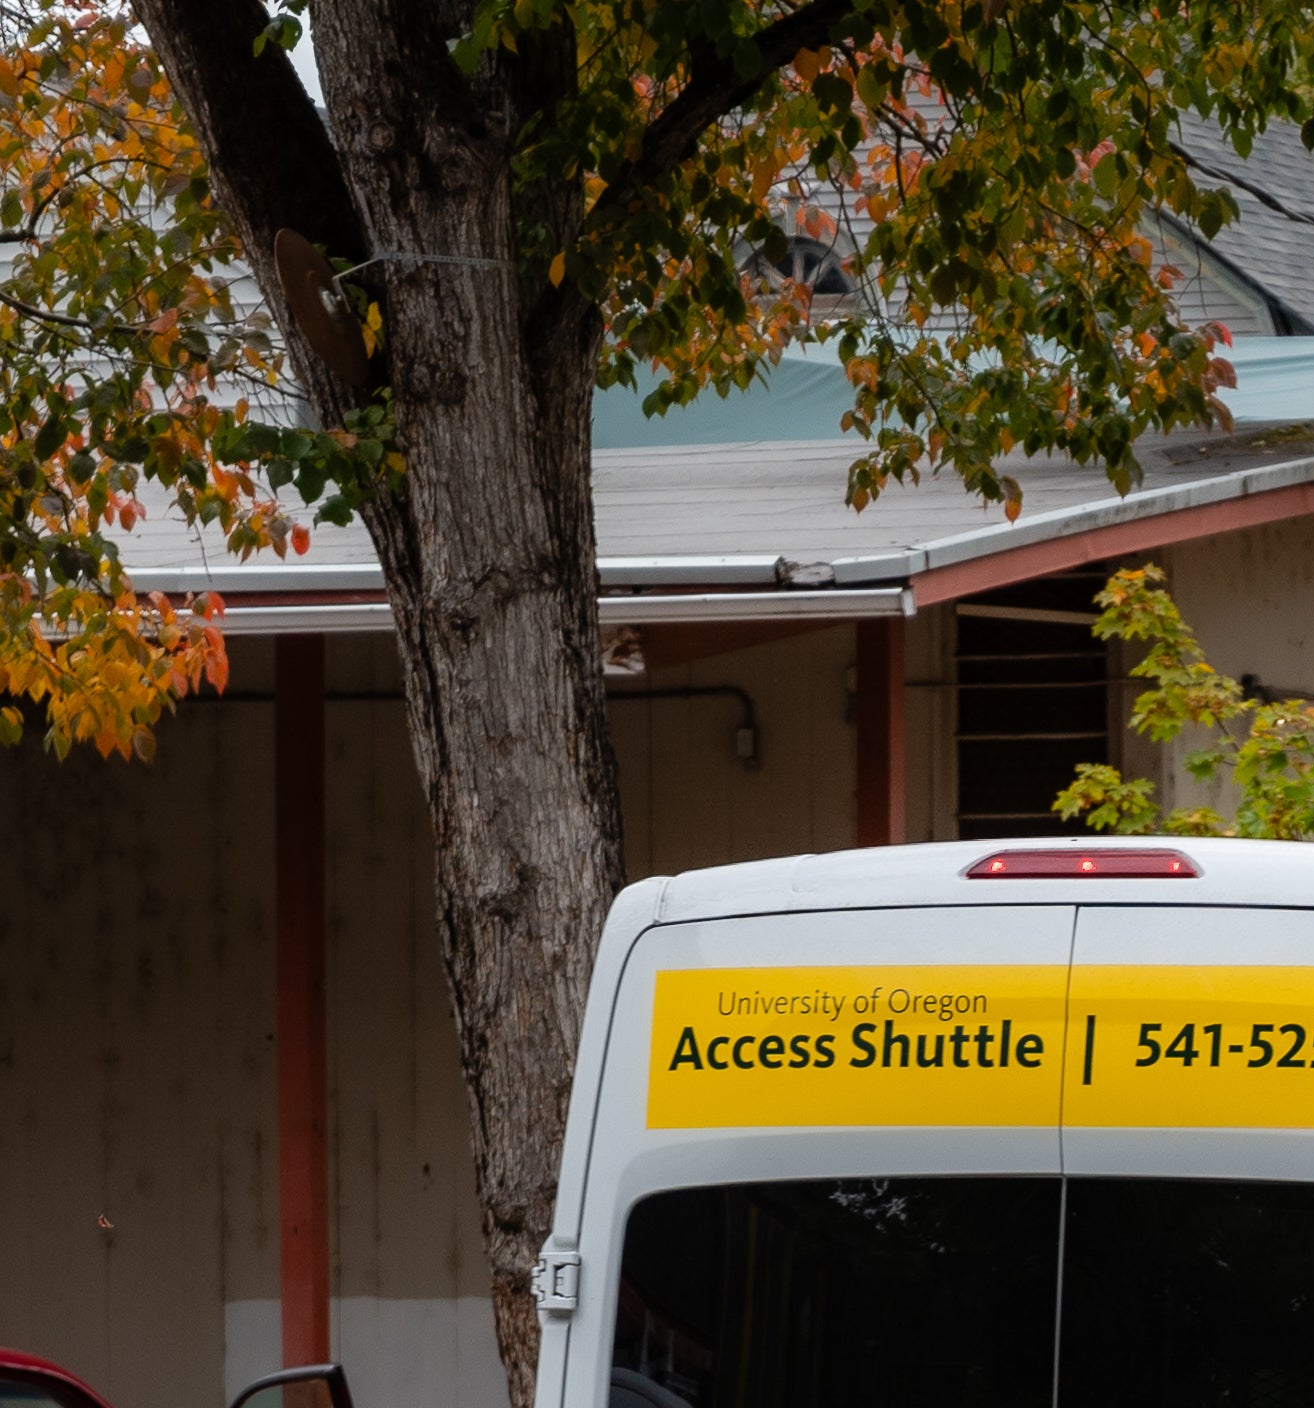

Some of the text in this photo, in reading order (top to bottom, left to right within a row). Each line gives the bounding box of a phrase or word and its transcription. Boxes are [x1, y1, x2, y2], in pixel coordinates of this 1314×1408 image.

[718, 987, 988, 1021] University of Oregon
[669, 1019, 1045, 1070] Access Shuttle
